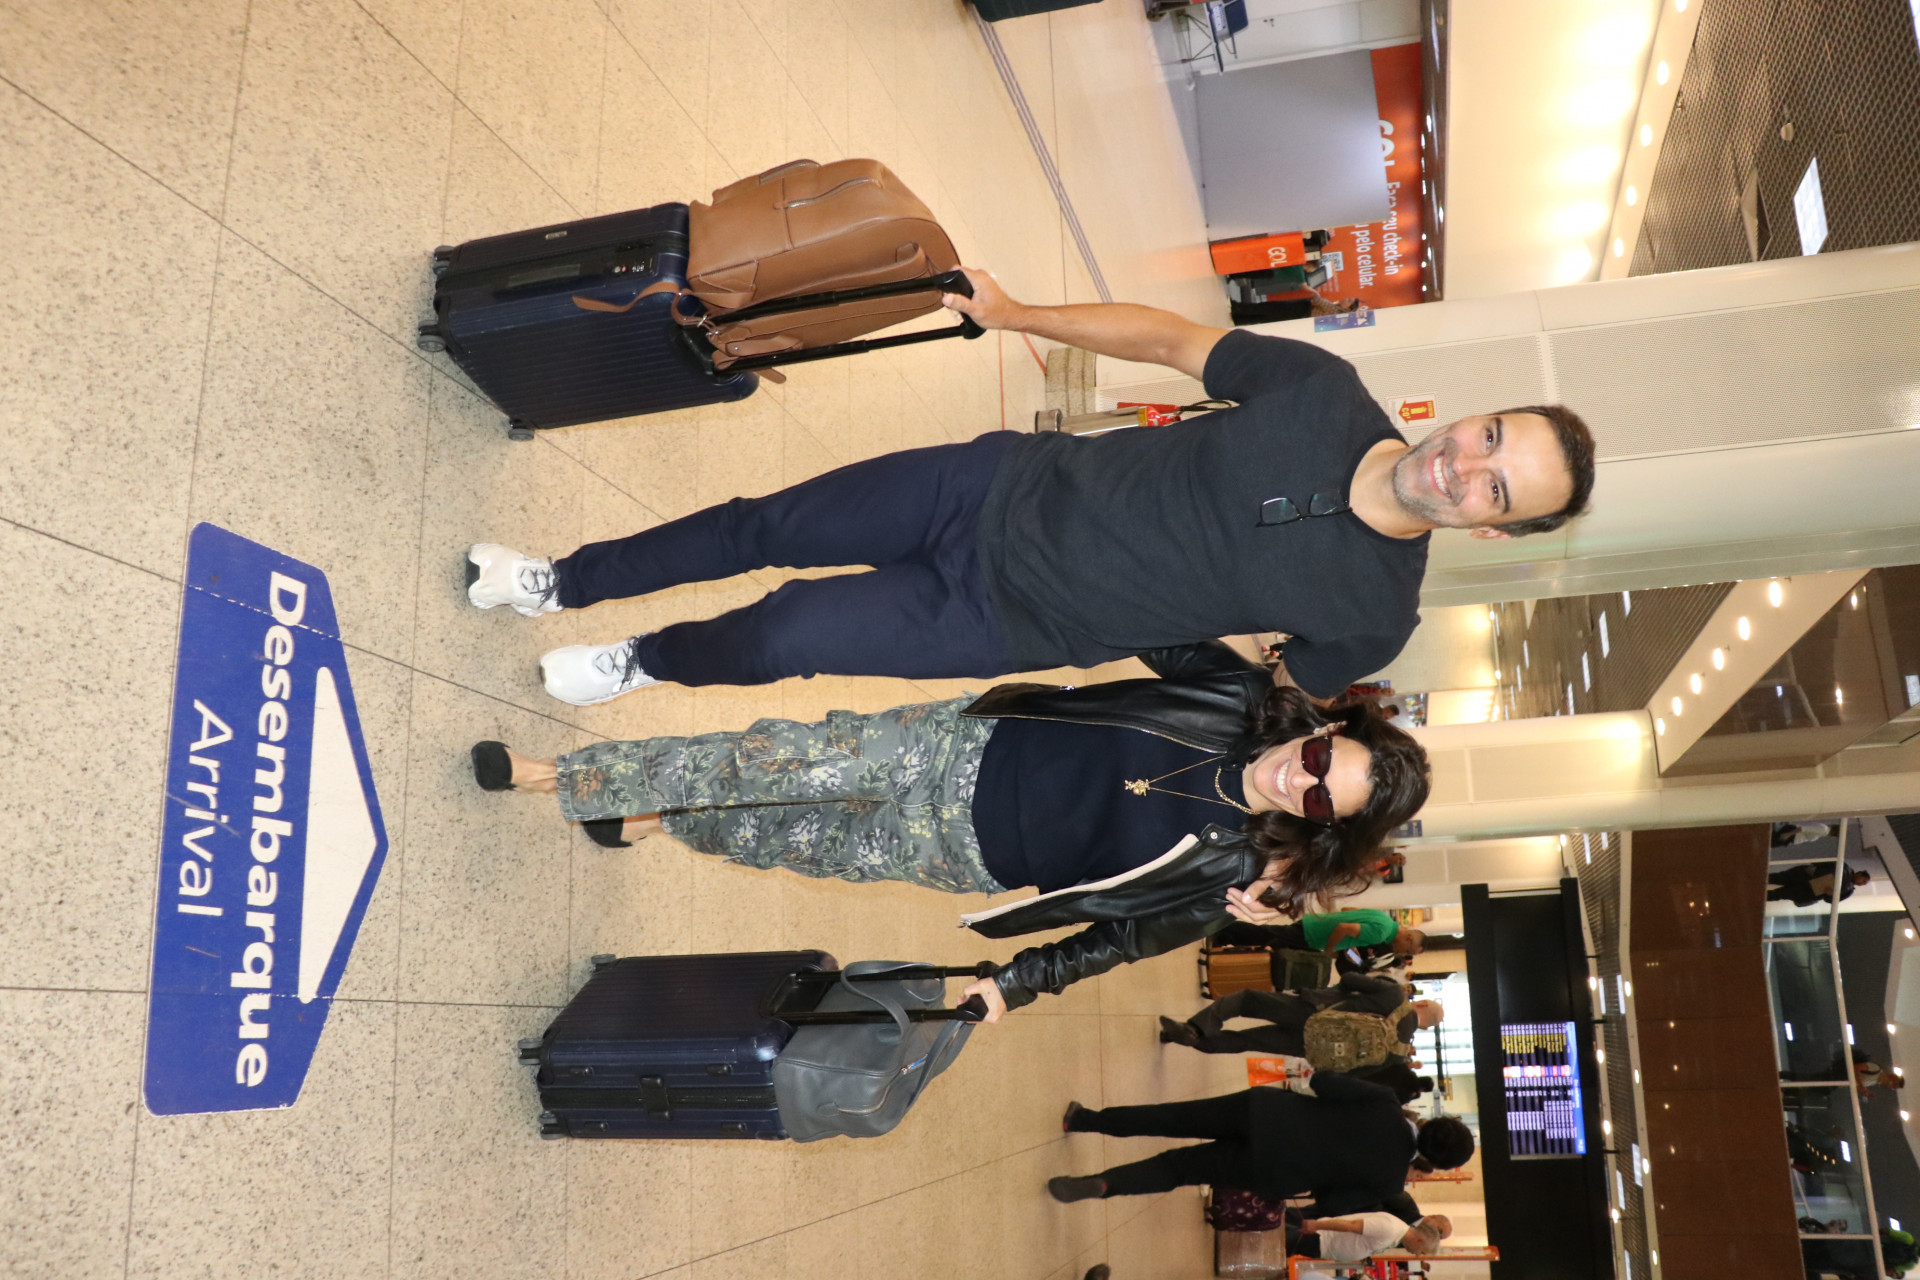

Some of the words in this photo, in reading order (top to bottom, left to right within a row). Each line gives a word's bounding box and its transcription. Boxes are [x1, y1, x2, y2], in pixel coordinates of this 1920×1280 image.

[1267, 246, 1288, 268] GOL
[1350, 230, 1375, 253] pelo
[1382, 232, 1404, 275] check-in
[1357, 254, 1377, 288] celular.
[178, 699, 234, 916] Arrival
[231, 571, 308, 1087] Desembarque
